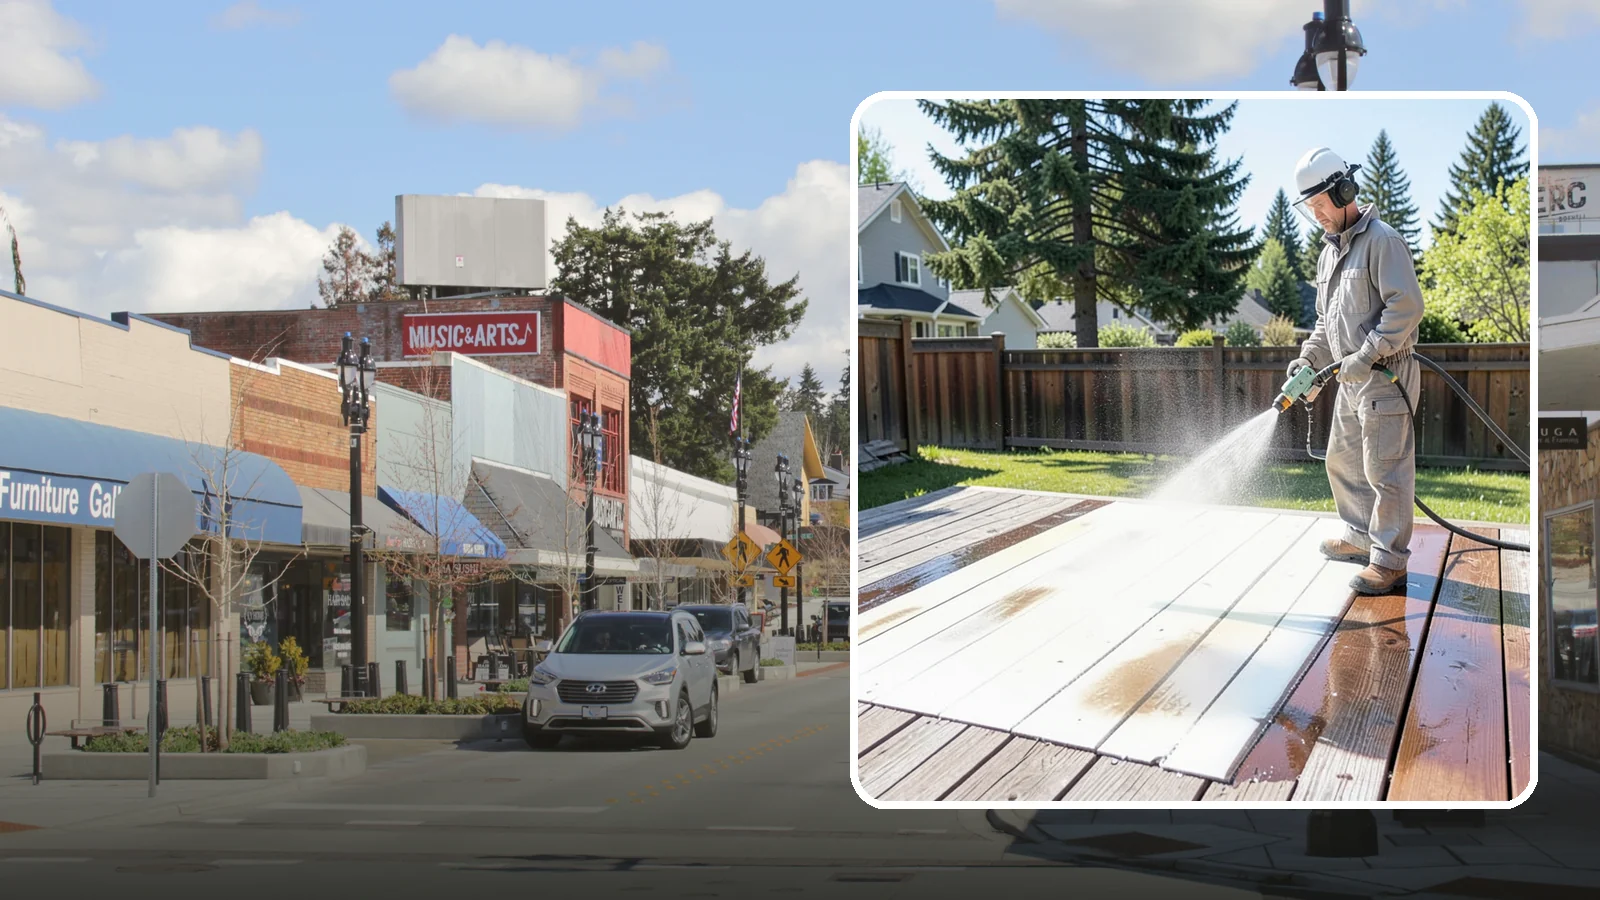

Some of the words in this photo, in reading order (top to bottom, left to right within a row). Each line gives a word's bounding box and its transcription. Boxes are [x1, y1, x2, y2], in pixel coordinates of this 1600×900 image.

[0, 471, 80, 516] Furniture
[89, 482, 122, 520] Gal
[453, 563, 480, 574] SUSHI
